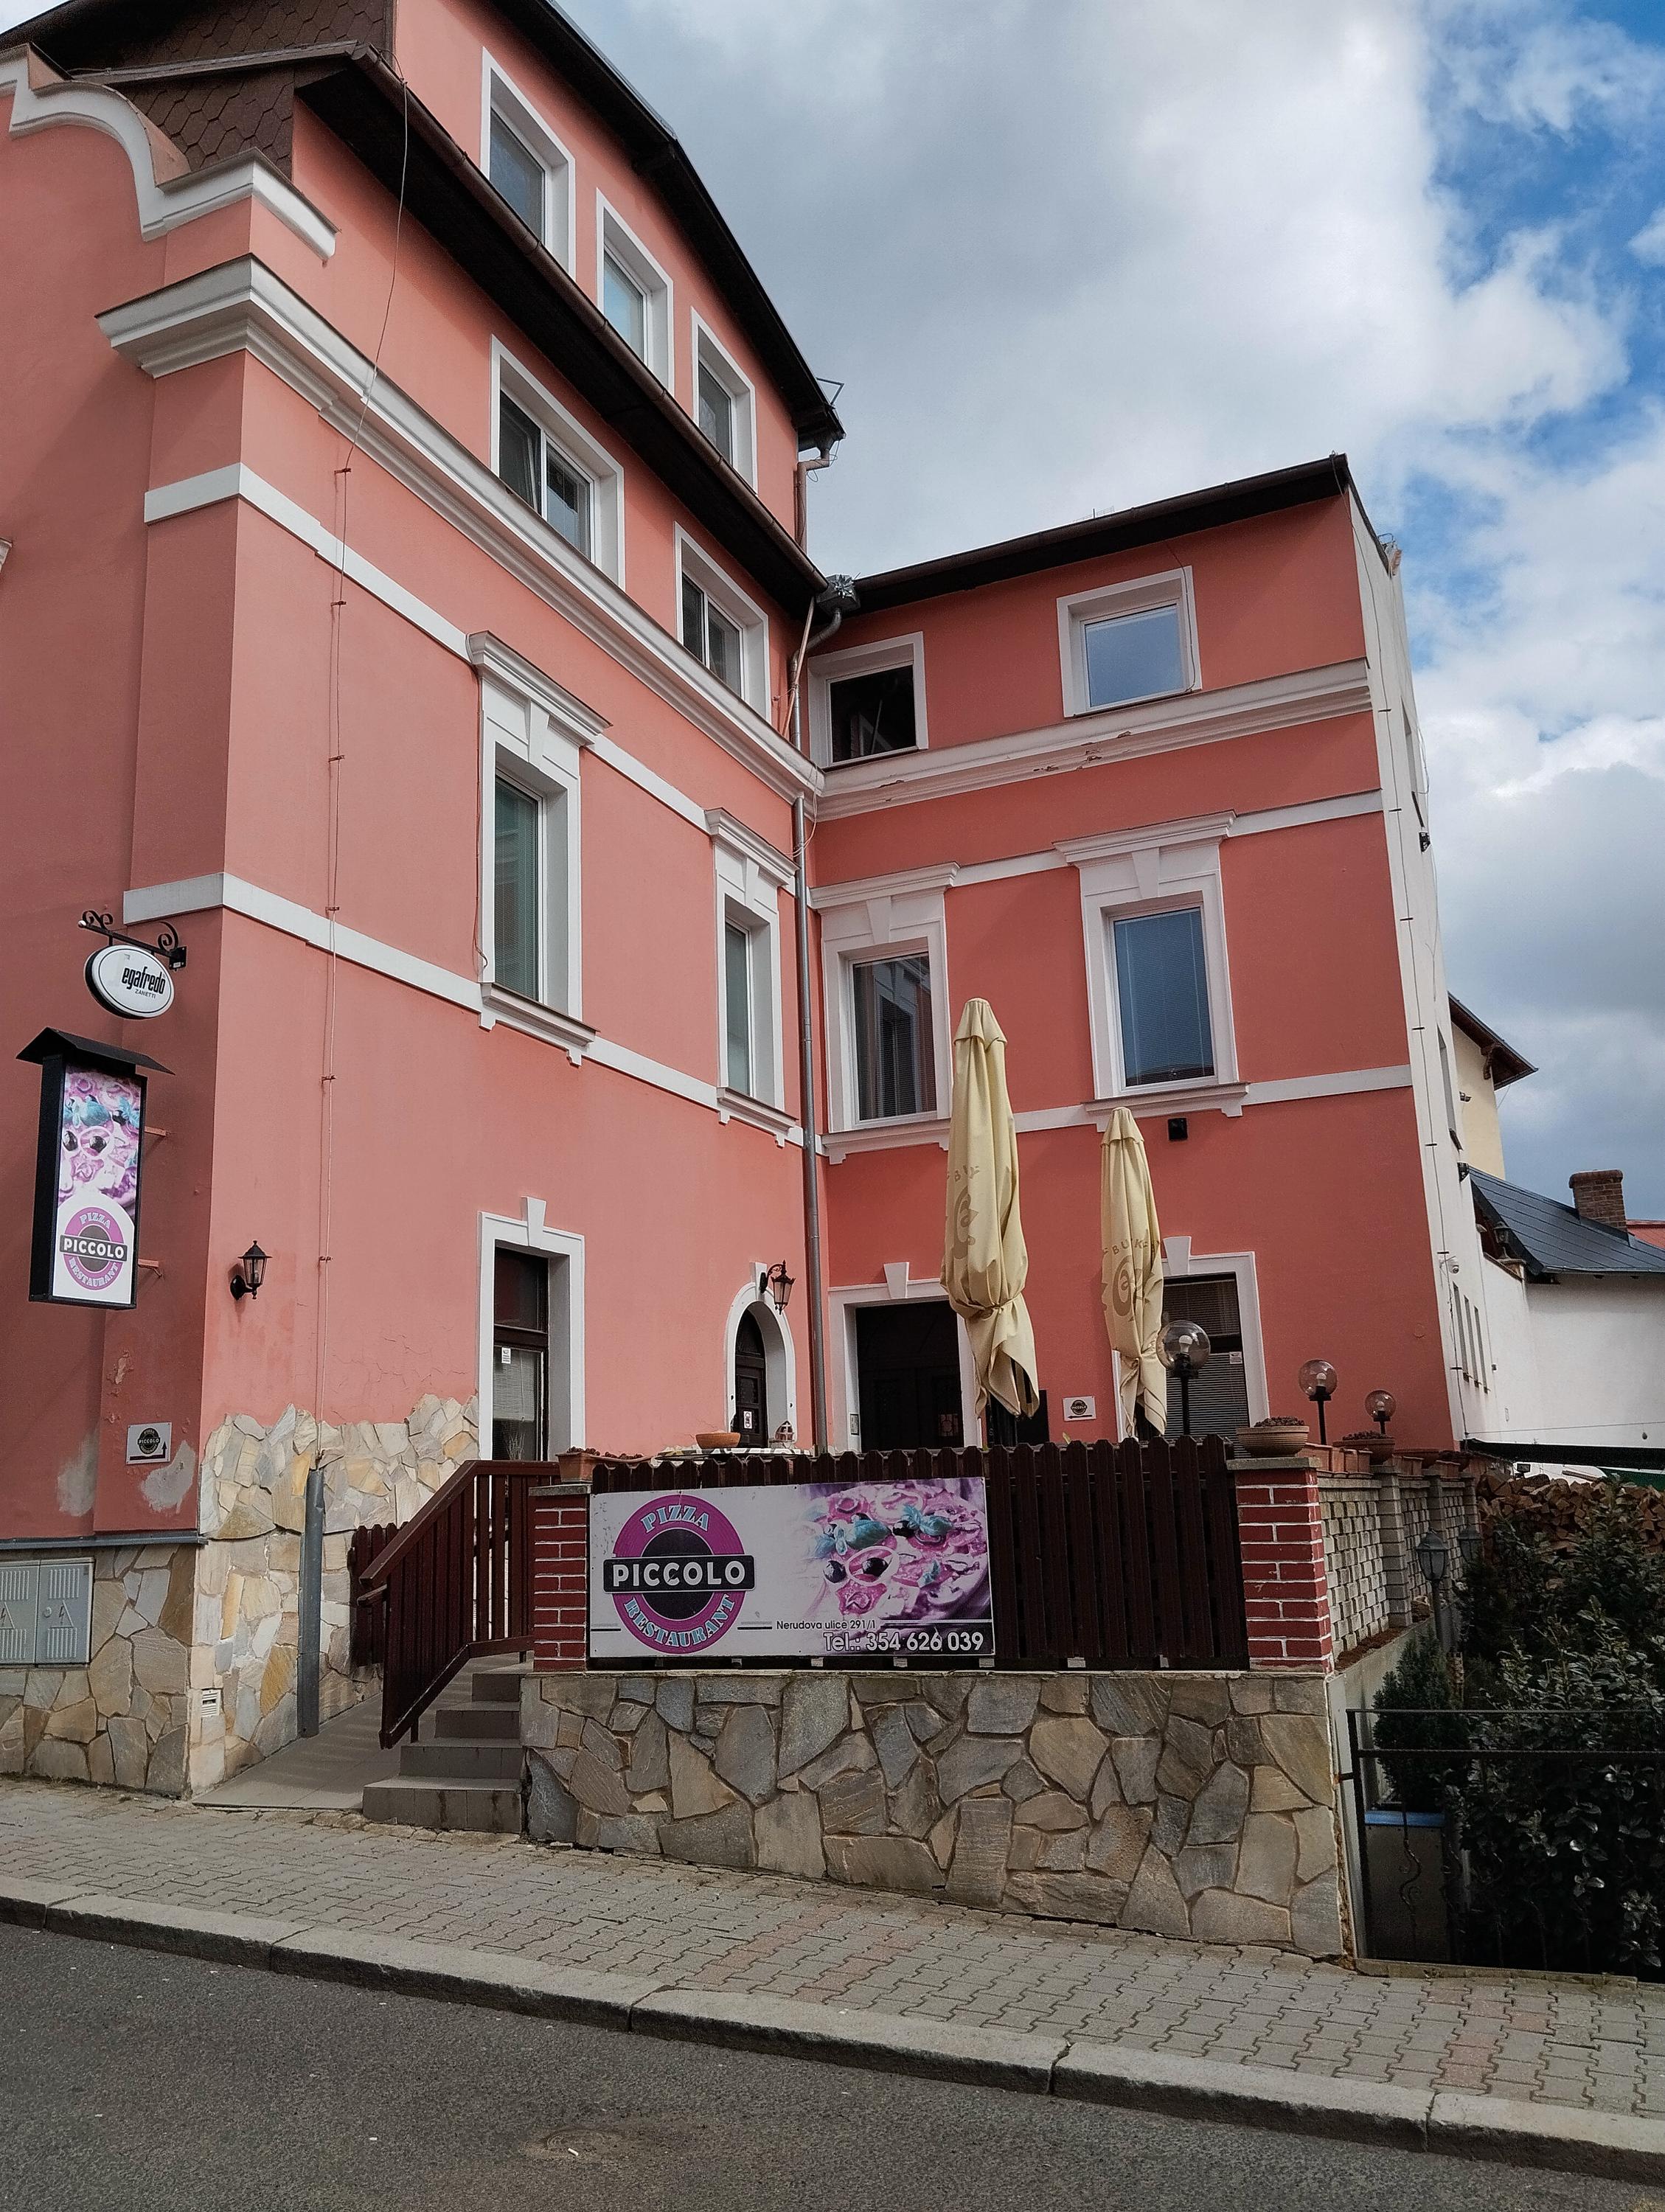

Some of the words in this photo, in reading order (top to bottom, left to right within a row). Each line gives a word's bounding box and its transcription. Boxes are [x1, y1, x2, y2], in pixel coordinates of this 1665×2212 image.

[122, 953, 166, 995] egafredo
[134, 989, 156, 999] ZANETTI
[80, 1212, 111, 1229] PIZZA
[63, 1238, 124, 1259] PICCOLO
[69, 1257, 119, 1287] RESTAURANT
[640, 1504, 709, 1533] PIZZA
[613, 1560, 745, 1587] PICCOLO
[624, 1593, 735, 1647] RESTAURANT
[776, 1620, 822, 1630] Nerudova
[824, 1620, 847, 1630] ulice
[849, 1619, 875, 1630] 291/1
[823, 1632, 861, 1652] Tel.:
[866, 1631, 901, 1651] 354
[906, 1632, 943, 1651] 626
[948, 1632, 984, 1651] 039
